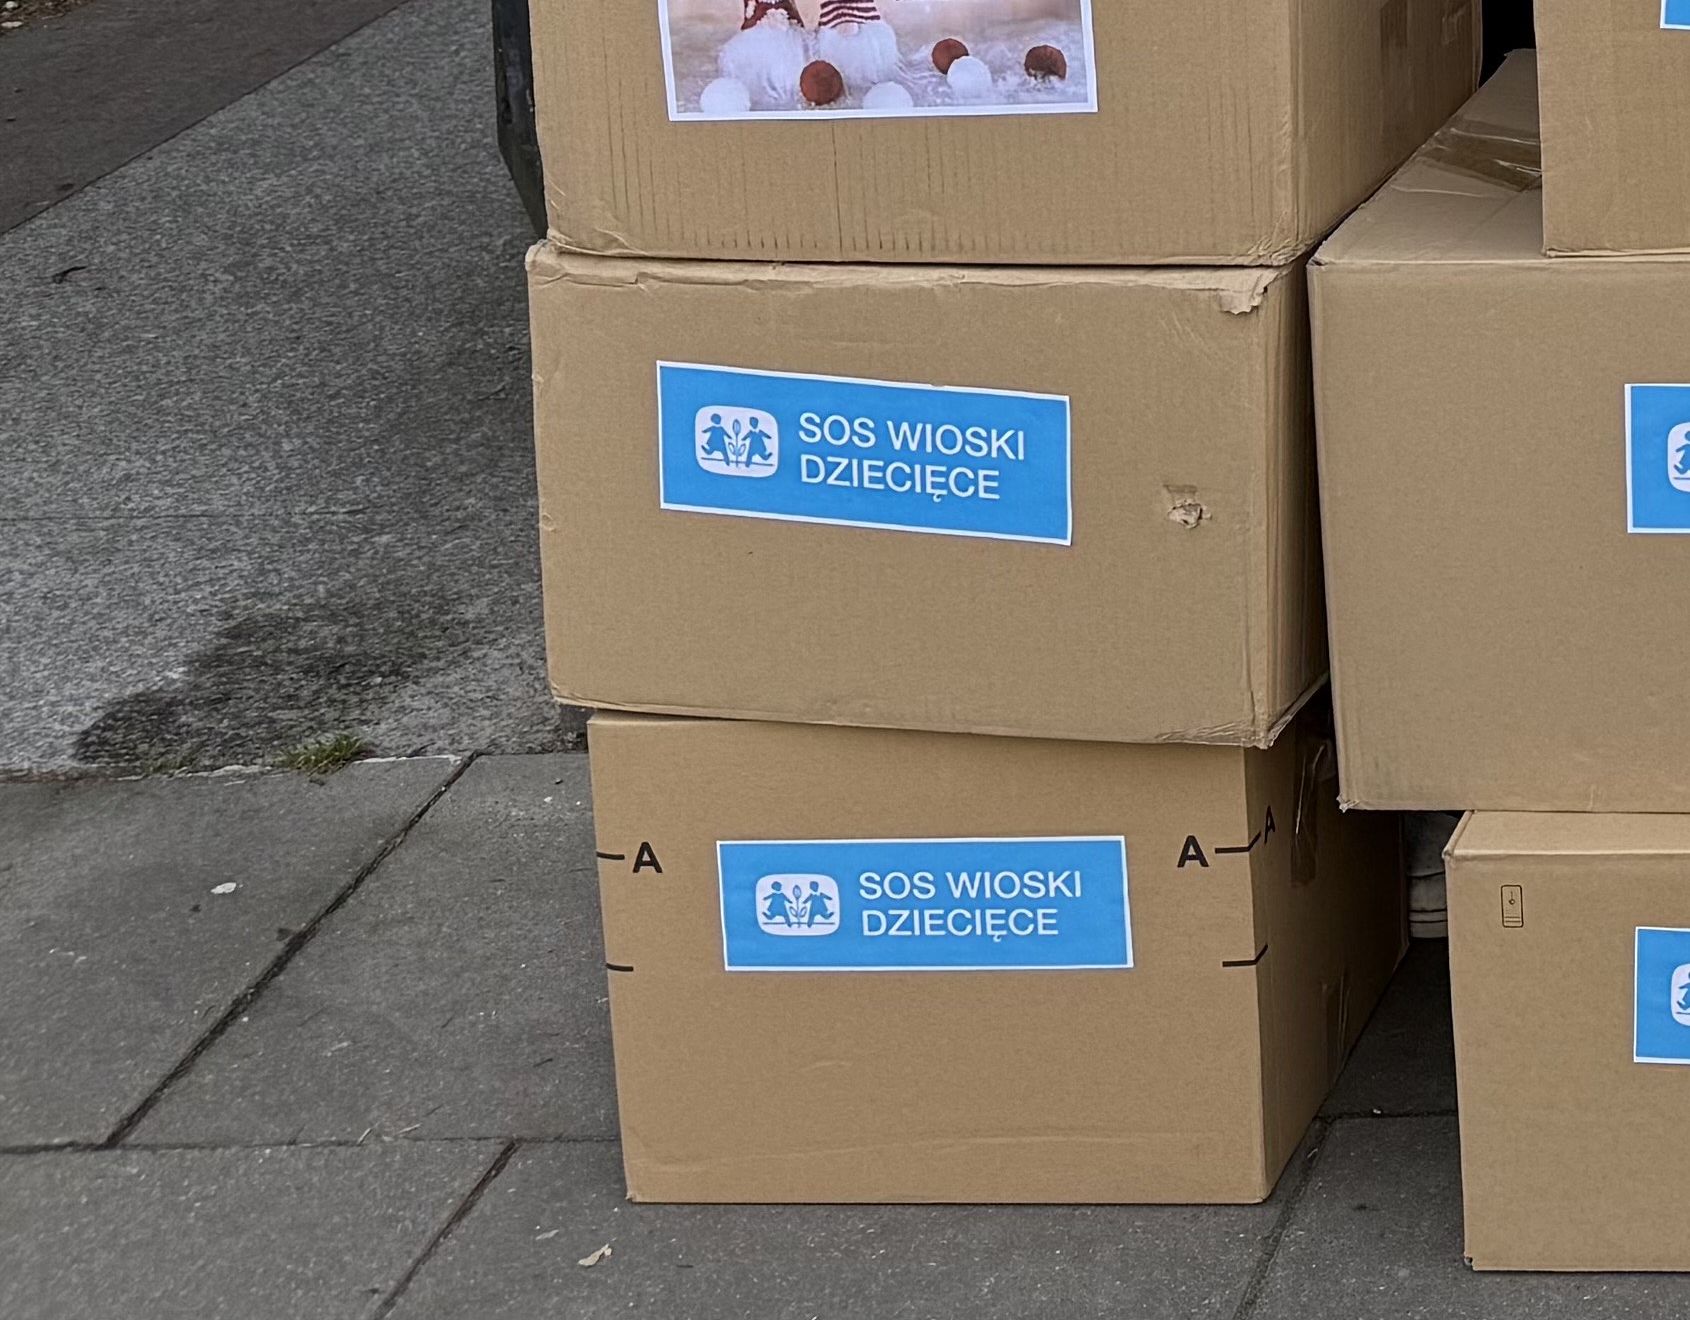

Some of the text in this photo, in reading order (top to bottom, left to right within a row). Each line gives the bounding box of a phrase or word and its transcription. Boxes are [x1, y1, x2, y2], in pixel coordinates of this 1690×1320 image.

[799, 413, 1024, 460] SOS WIOSKI
[801, 455, 999, 502] DZIECIĘCE
[1264, 805, 1276, 845] A
[632, 841, 663, 874] A
[1177, 834, 1210, 868] A
[860, 871, 1081, 899] SOS WIOSKI
[863, 909, 1058, 942] DZIECIĘCE
